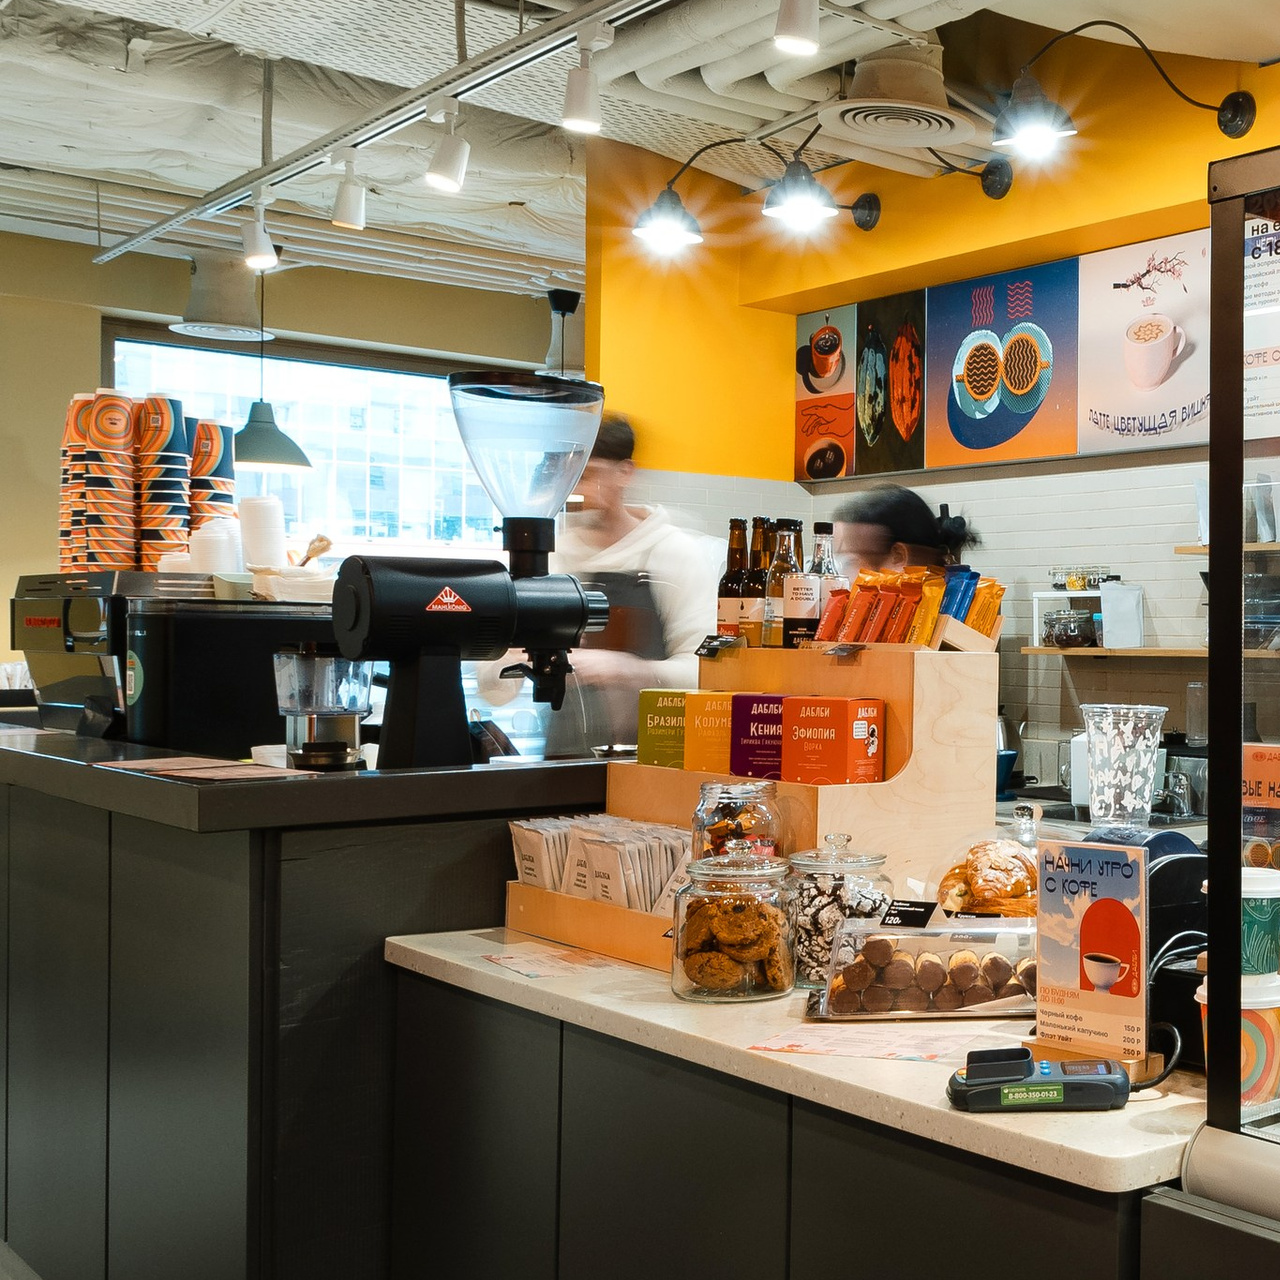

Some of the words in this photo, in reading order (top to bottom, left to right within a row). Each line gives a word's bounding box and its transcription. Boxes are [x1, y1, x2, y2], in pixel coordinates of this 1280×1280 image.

[1251, 222, 1268, 236] на
[1251, 246, 1261, 259] с
[1272, 350, 1280, 362] С
[1089, 409, 1110, 430] ЛАТТЕ
[1113, 409, 1177, 434] ЦВЕТУЩАЯ
[751, 703, 783, 715] ДАБЛБИ
[800, 707, 830, 718] ДАБЛБИ
[647, 714, 685, 728] БРАЗИЛ
[750, 722, 783, 737] КЕНИЯ
[792, 725, 835, 740] ЭФИОПИЯ
[1044, 855, 1092, 875] НАЧНИ
[1098, 860, 1134, 879] УТРО
[1045, 877, 1056, 893] С
[1062, 878, 1098, 897] КОФЕ
[1050, 988, 1080, 999] БУДНЯМ
[1066, 1013, 1083, 1022] кофе
[1040, 1020, 1076, 1032] Маленький
[1077, 1026, 1109, 1038] капучино
[1123, 1036, 1135, 1044] 200
[1040, 1031, 1056, 1040] Флэт
[1057, 1034, 1073, 1043] Уайт
[1123, 1048, 1135, 1056] 250
